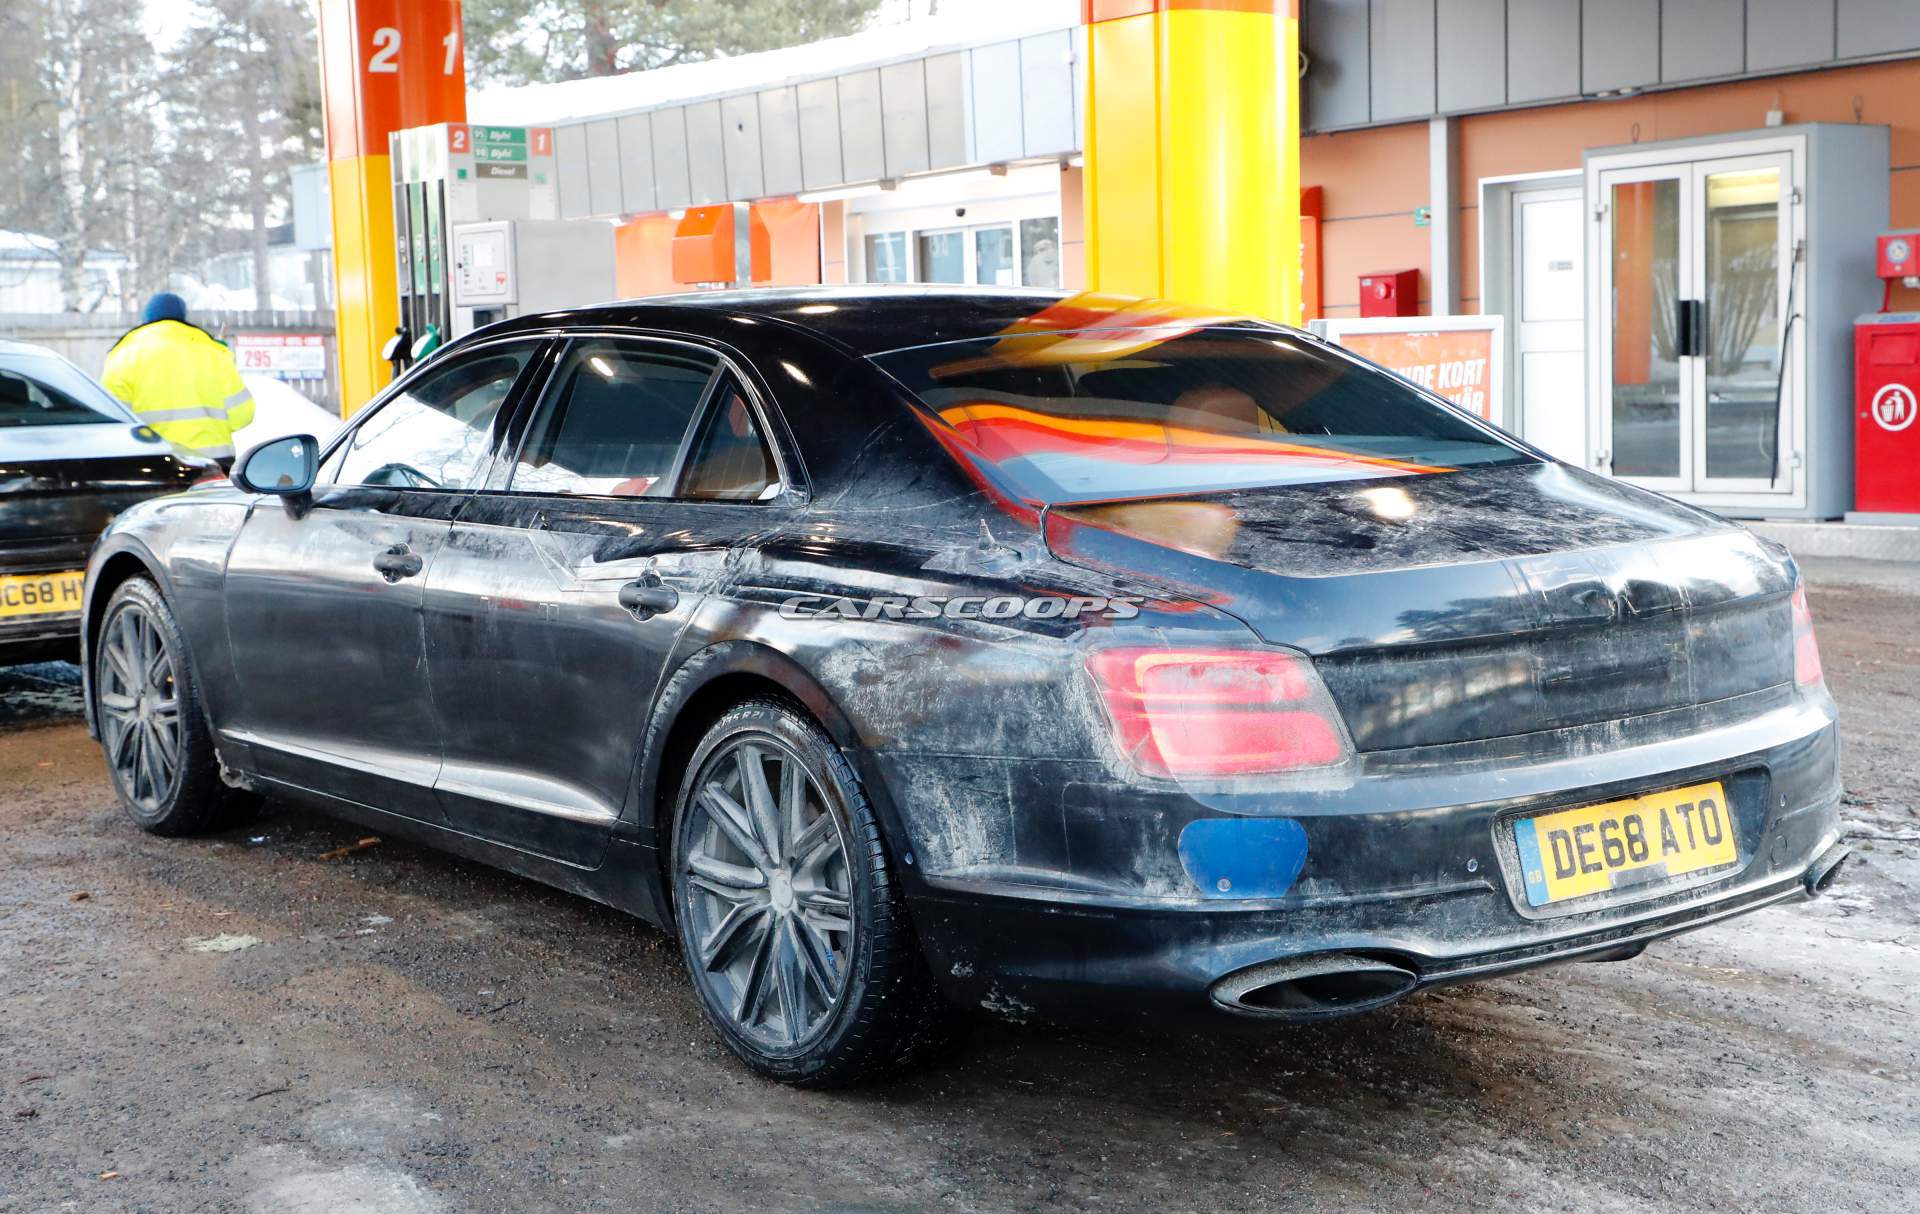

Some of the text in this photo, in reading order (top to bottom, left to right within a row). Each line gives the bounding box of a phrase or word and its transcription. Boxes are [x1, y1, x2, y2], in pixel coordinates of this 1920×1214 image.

[368, 27, 401, 72] 2
[443, 31, 458, 75] 1
[453, 131, 465, 149] 2
[537, 133, 546, 152] 1
[490, 165, 516, 176] Diesel
[244, 350, 272, 368] 295
[1437, 358, 1486, 389] KORT
[1547, 798, 1723, 881] DE68 ATO
